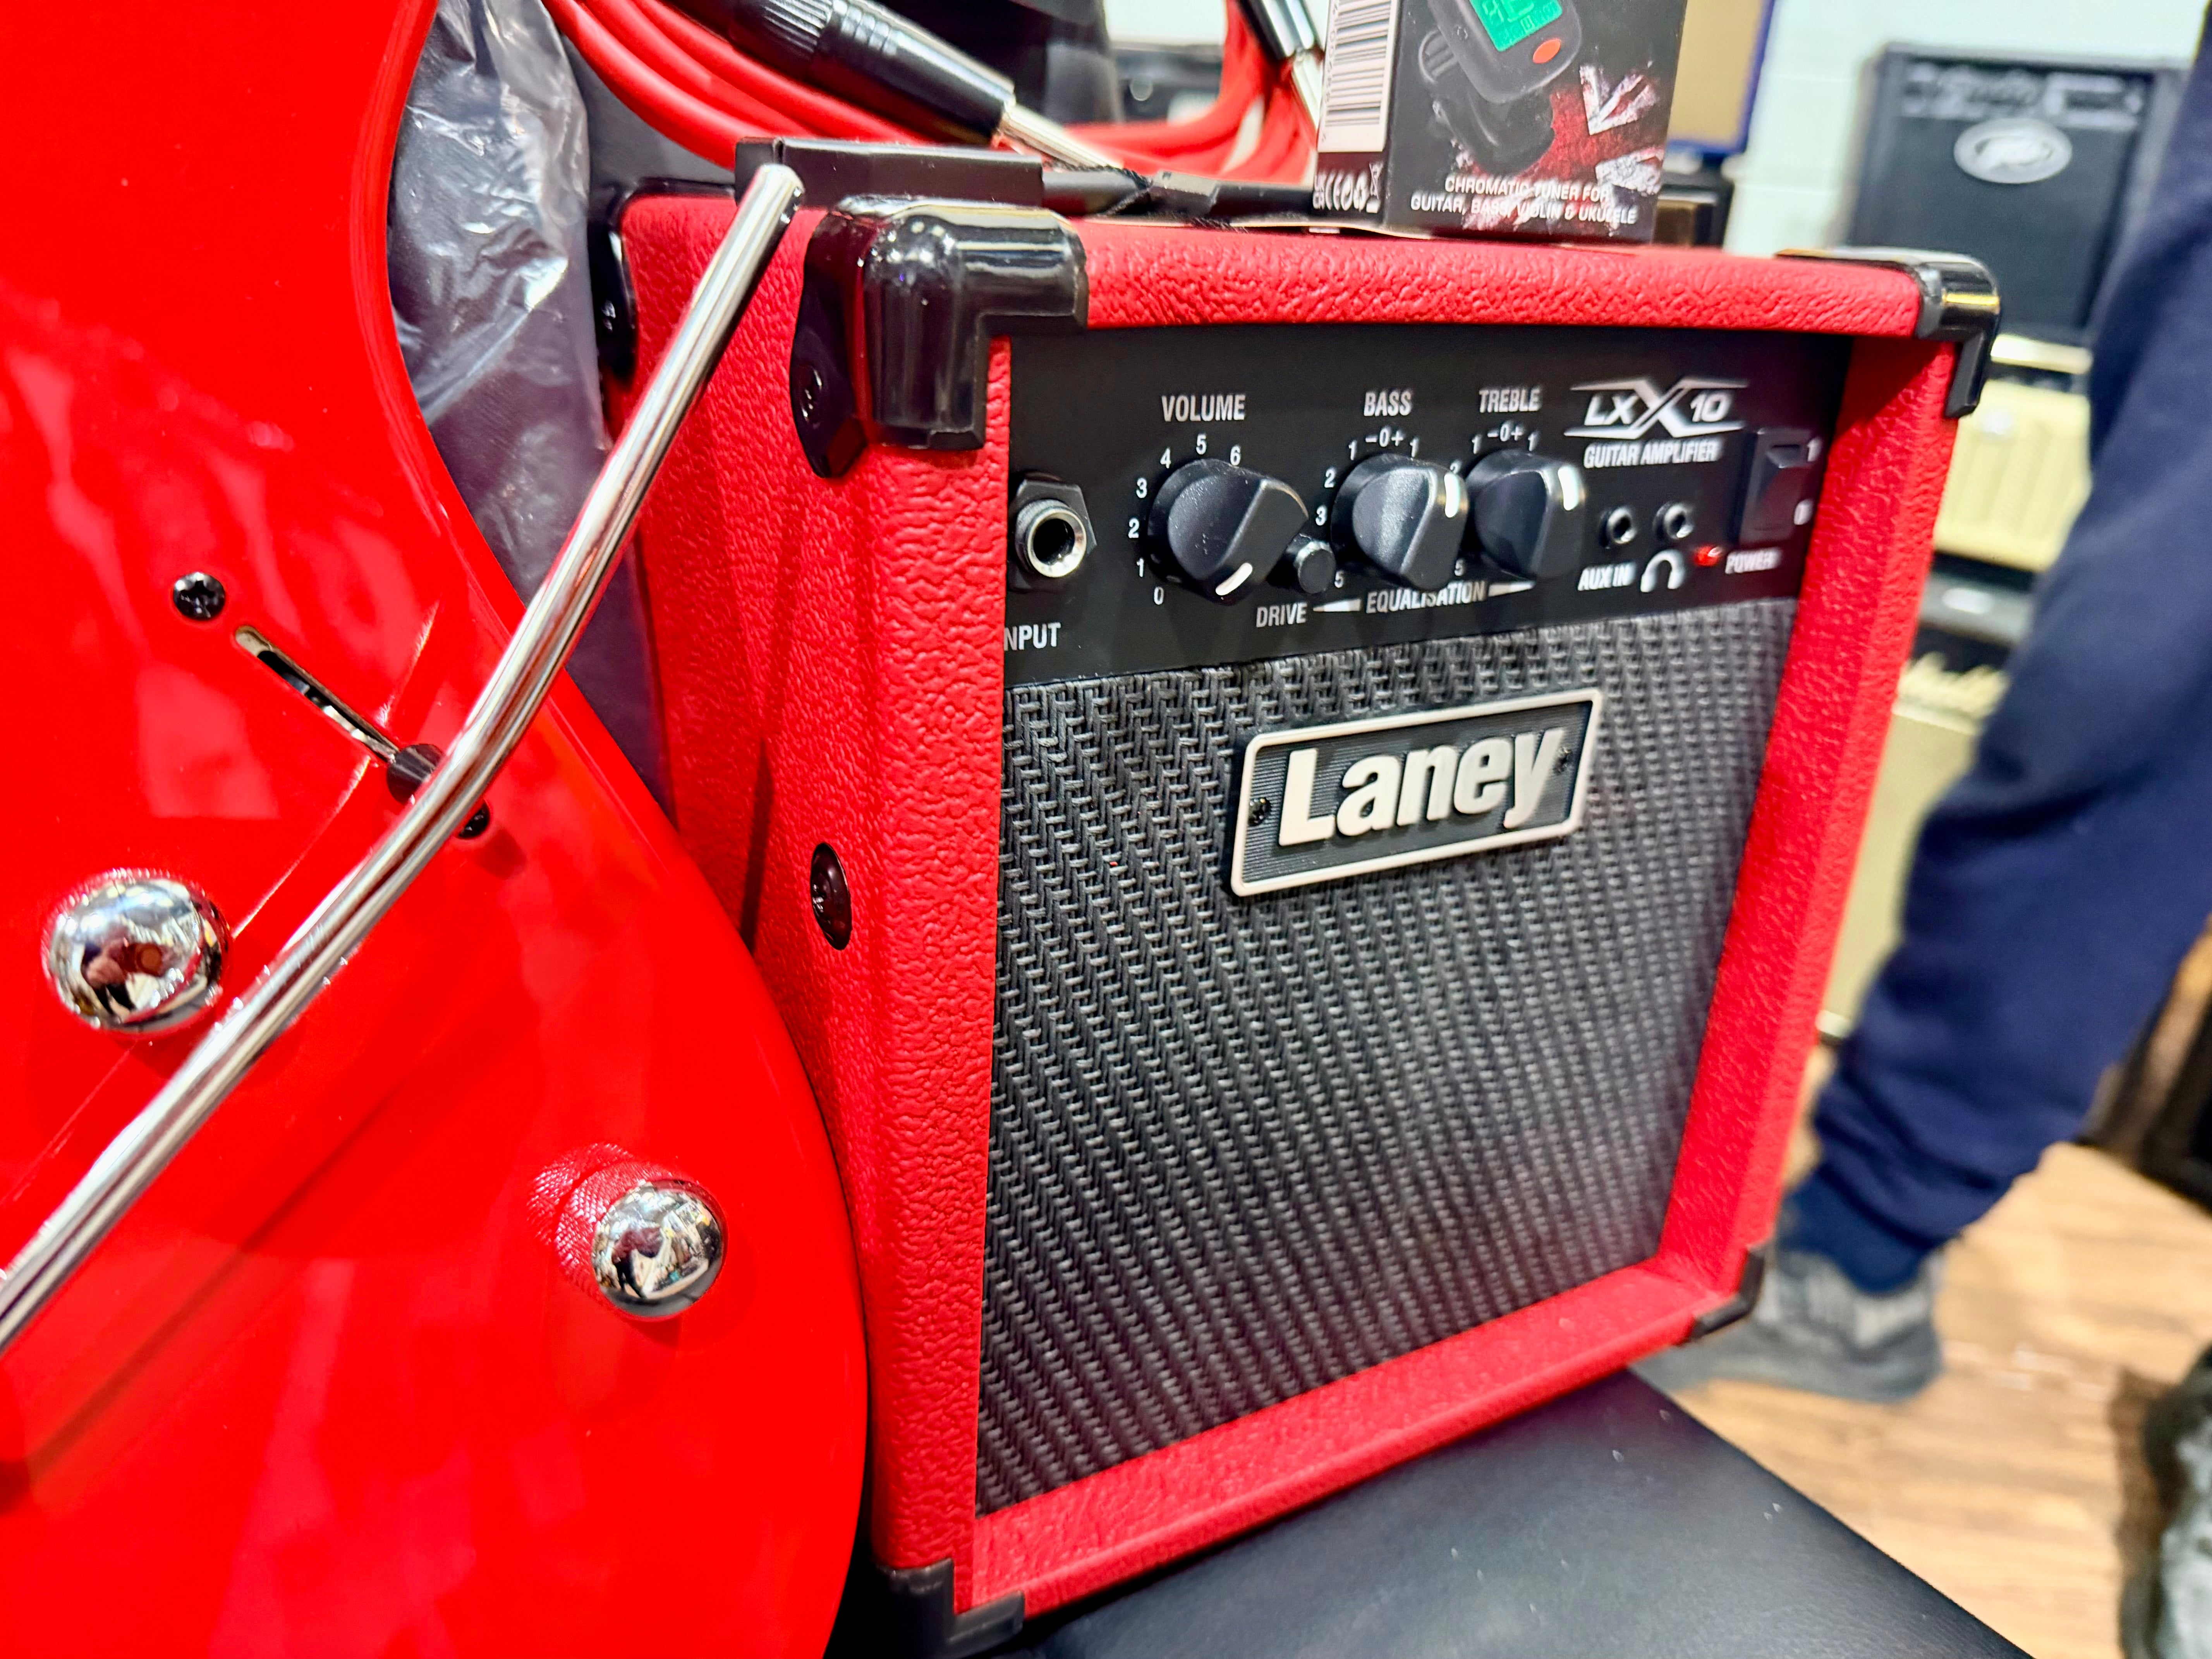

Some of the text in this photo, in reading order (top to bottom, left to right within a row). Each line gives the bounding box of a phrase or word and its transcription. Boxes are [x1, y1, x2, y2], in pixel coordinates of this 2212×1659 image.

[1445, 174, 1611, 202] CHROMATIC TUNER FOR
[1411, 192, 1466, 215] GUITAR,
[1578, 204, 1637, 224] UKULELE
[1162, 395, 1245, 421] VOLUME
[1364, 390, 1412, 417] BASS
[1479, 388, 1542, 413] TREBLE
[1196, 436, 1207, 455] 5
[1348, 440, 1357, 460] 1
[1410, 438, 1419, 457] 1
[1472, 435, 1481, 454] 1
[1528, 431, 1538, 452] 1
[1160, 448, 1171, 469] 4
[1230, 446, 1241, 466] 6
[1584, 438, 1723, 469] GUITAR AMPLIFIER
[1136, 478, 1147, 498] 3
[1324, 468, 1336, 488] 2
[1316, 507, 1327, 526] 3
[1128, 519, 1139, 538] 2
[1137, 558, 1144, 577] 1
[1578, 562, 1636, 591] AUX IN
[1334, 570, 1345, 588] 5
[1154, 587, 1164, 605] 0
[1366, 581, 1487, 613] EQUALISATION
[1256, 603, 1308, 628] DRIVE
[1004, 622, 1061, 651] NPUT
[1278, 728, 1565, 847] Laney
